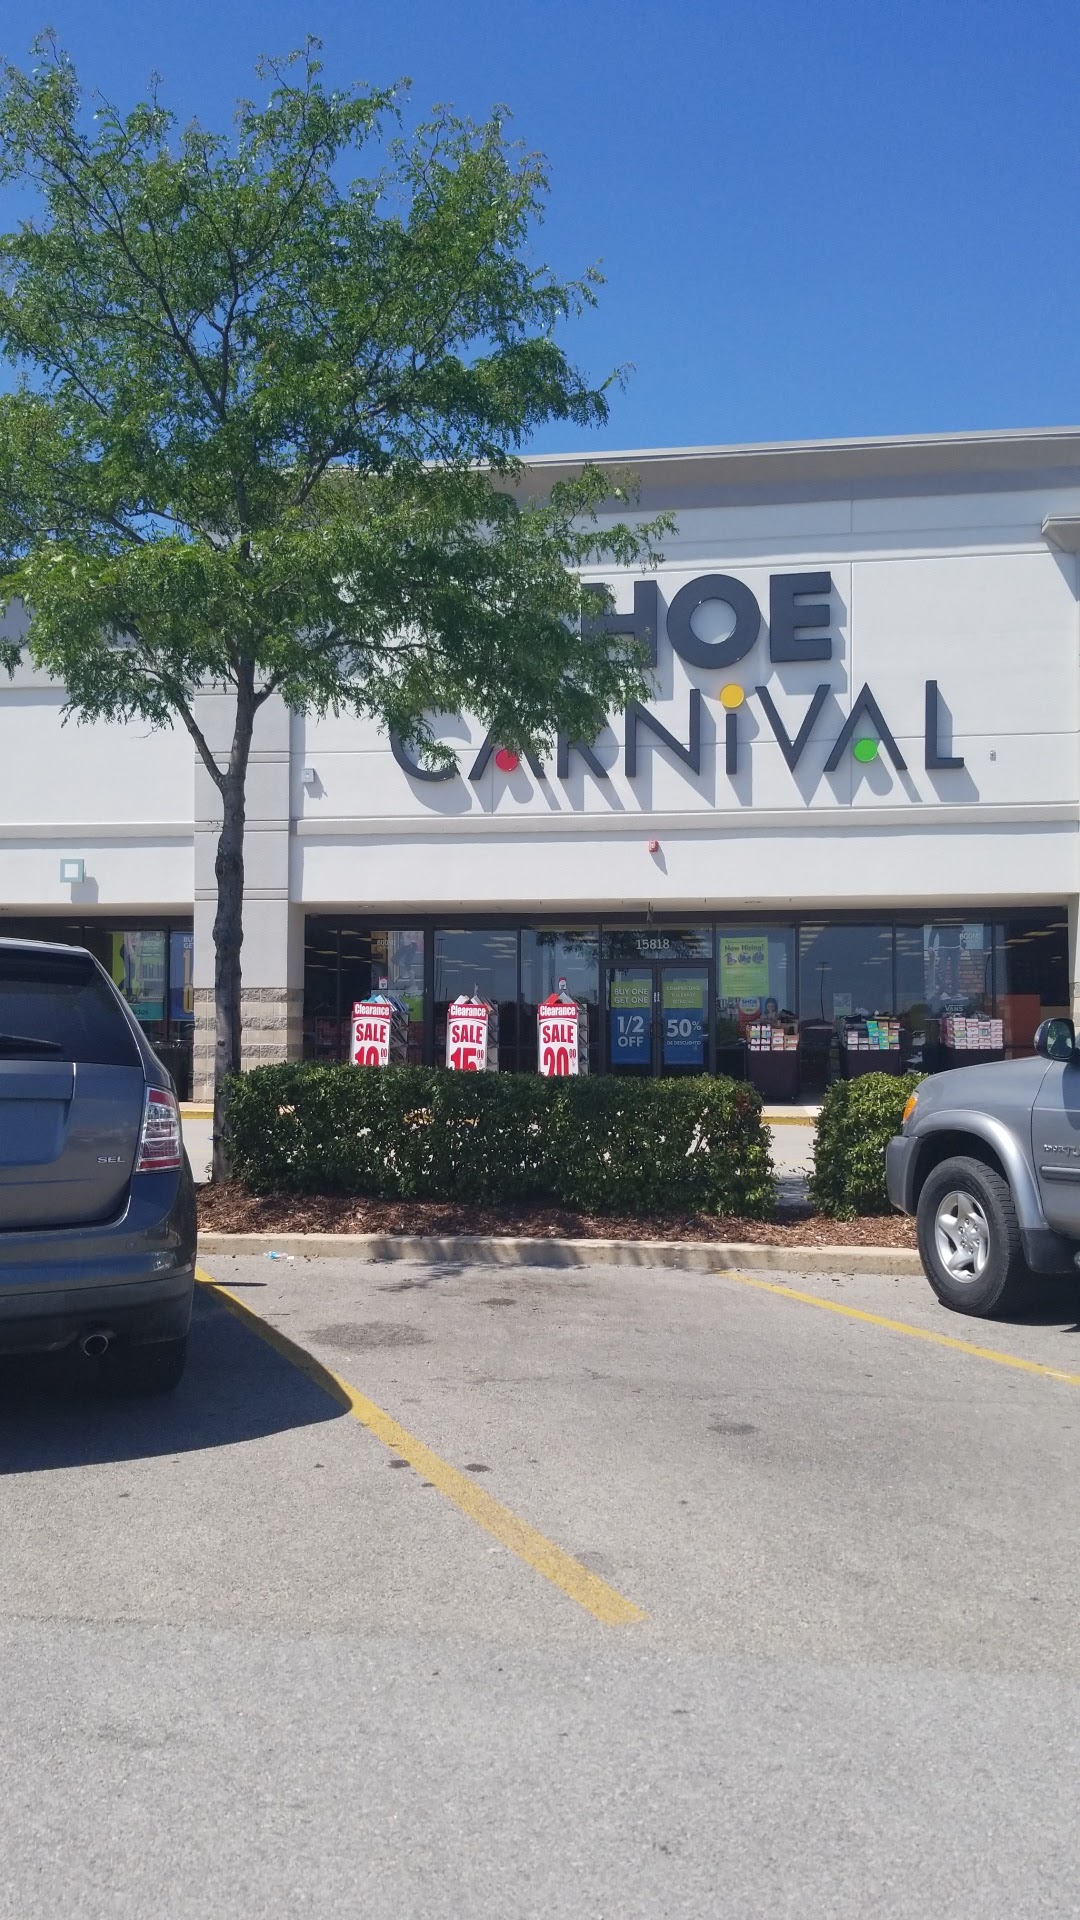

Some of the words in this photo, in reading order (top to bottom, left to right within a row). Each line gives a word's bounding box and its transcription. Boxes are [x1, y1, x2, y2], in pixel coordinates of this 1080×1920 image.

[581, 571, 833, 669] HOE
[636, 938, 670, 950] 15818
[631, 996, 649, 1004] ONE
[355, 1003, 390, 1016] Clearance
[450, 1005, 486, 1017] Clearance
[540, 1005, 576, 1016] Clearance
[617, 1015, 645, 1035] 1/2
[666, 1018, 702, 1037] 50%
[356, 1022, 387, 1044] SALE
[452, 1024, 483, 1045] SALE
[542, 1023, 574, 1044] SALE
[617, 1036, 644, 1047] OFF
[97, 1156, 126, 1164] SEL
